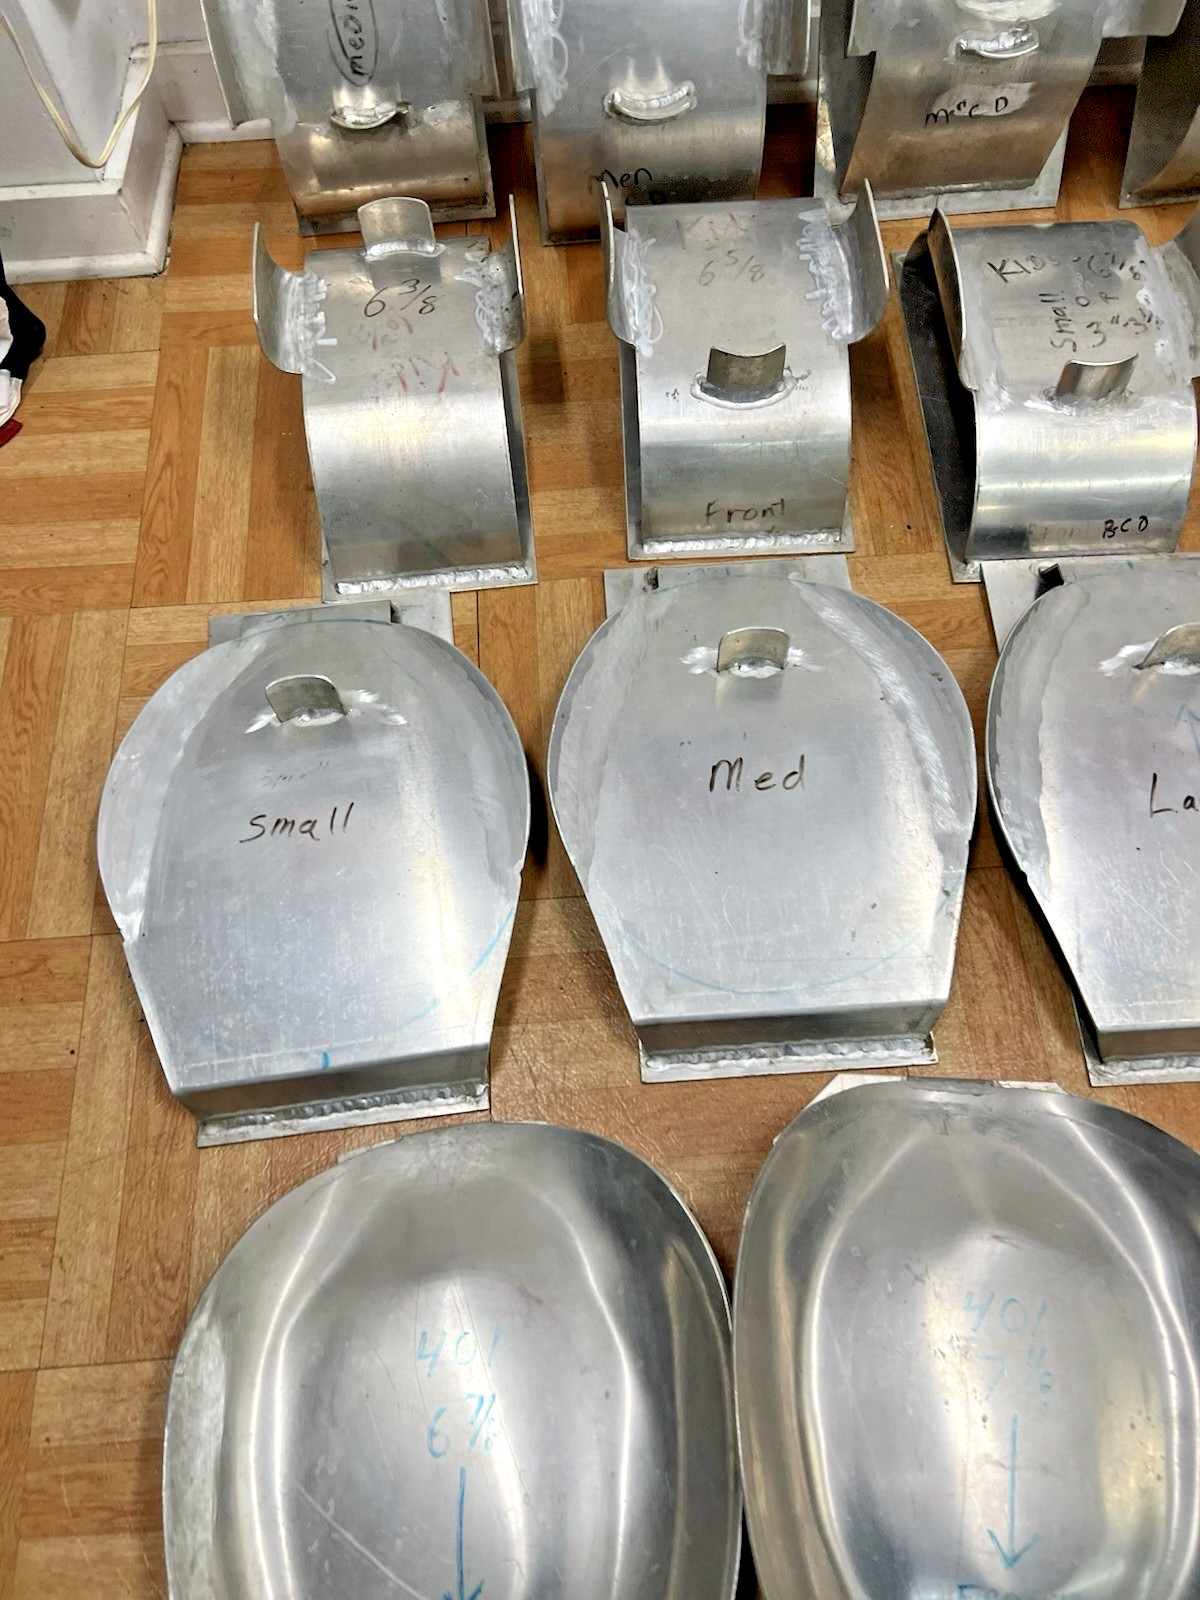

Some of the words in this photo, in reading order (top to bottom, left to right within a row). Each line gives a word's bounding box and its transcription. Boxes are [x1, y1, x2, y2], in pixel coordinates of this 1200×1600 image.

[705, 498, 785, 526] Front
[708, 754, 805, 793] Med
[416, 1321, 500, 1378] 401
